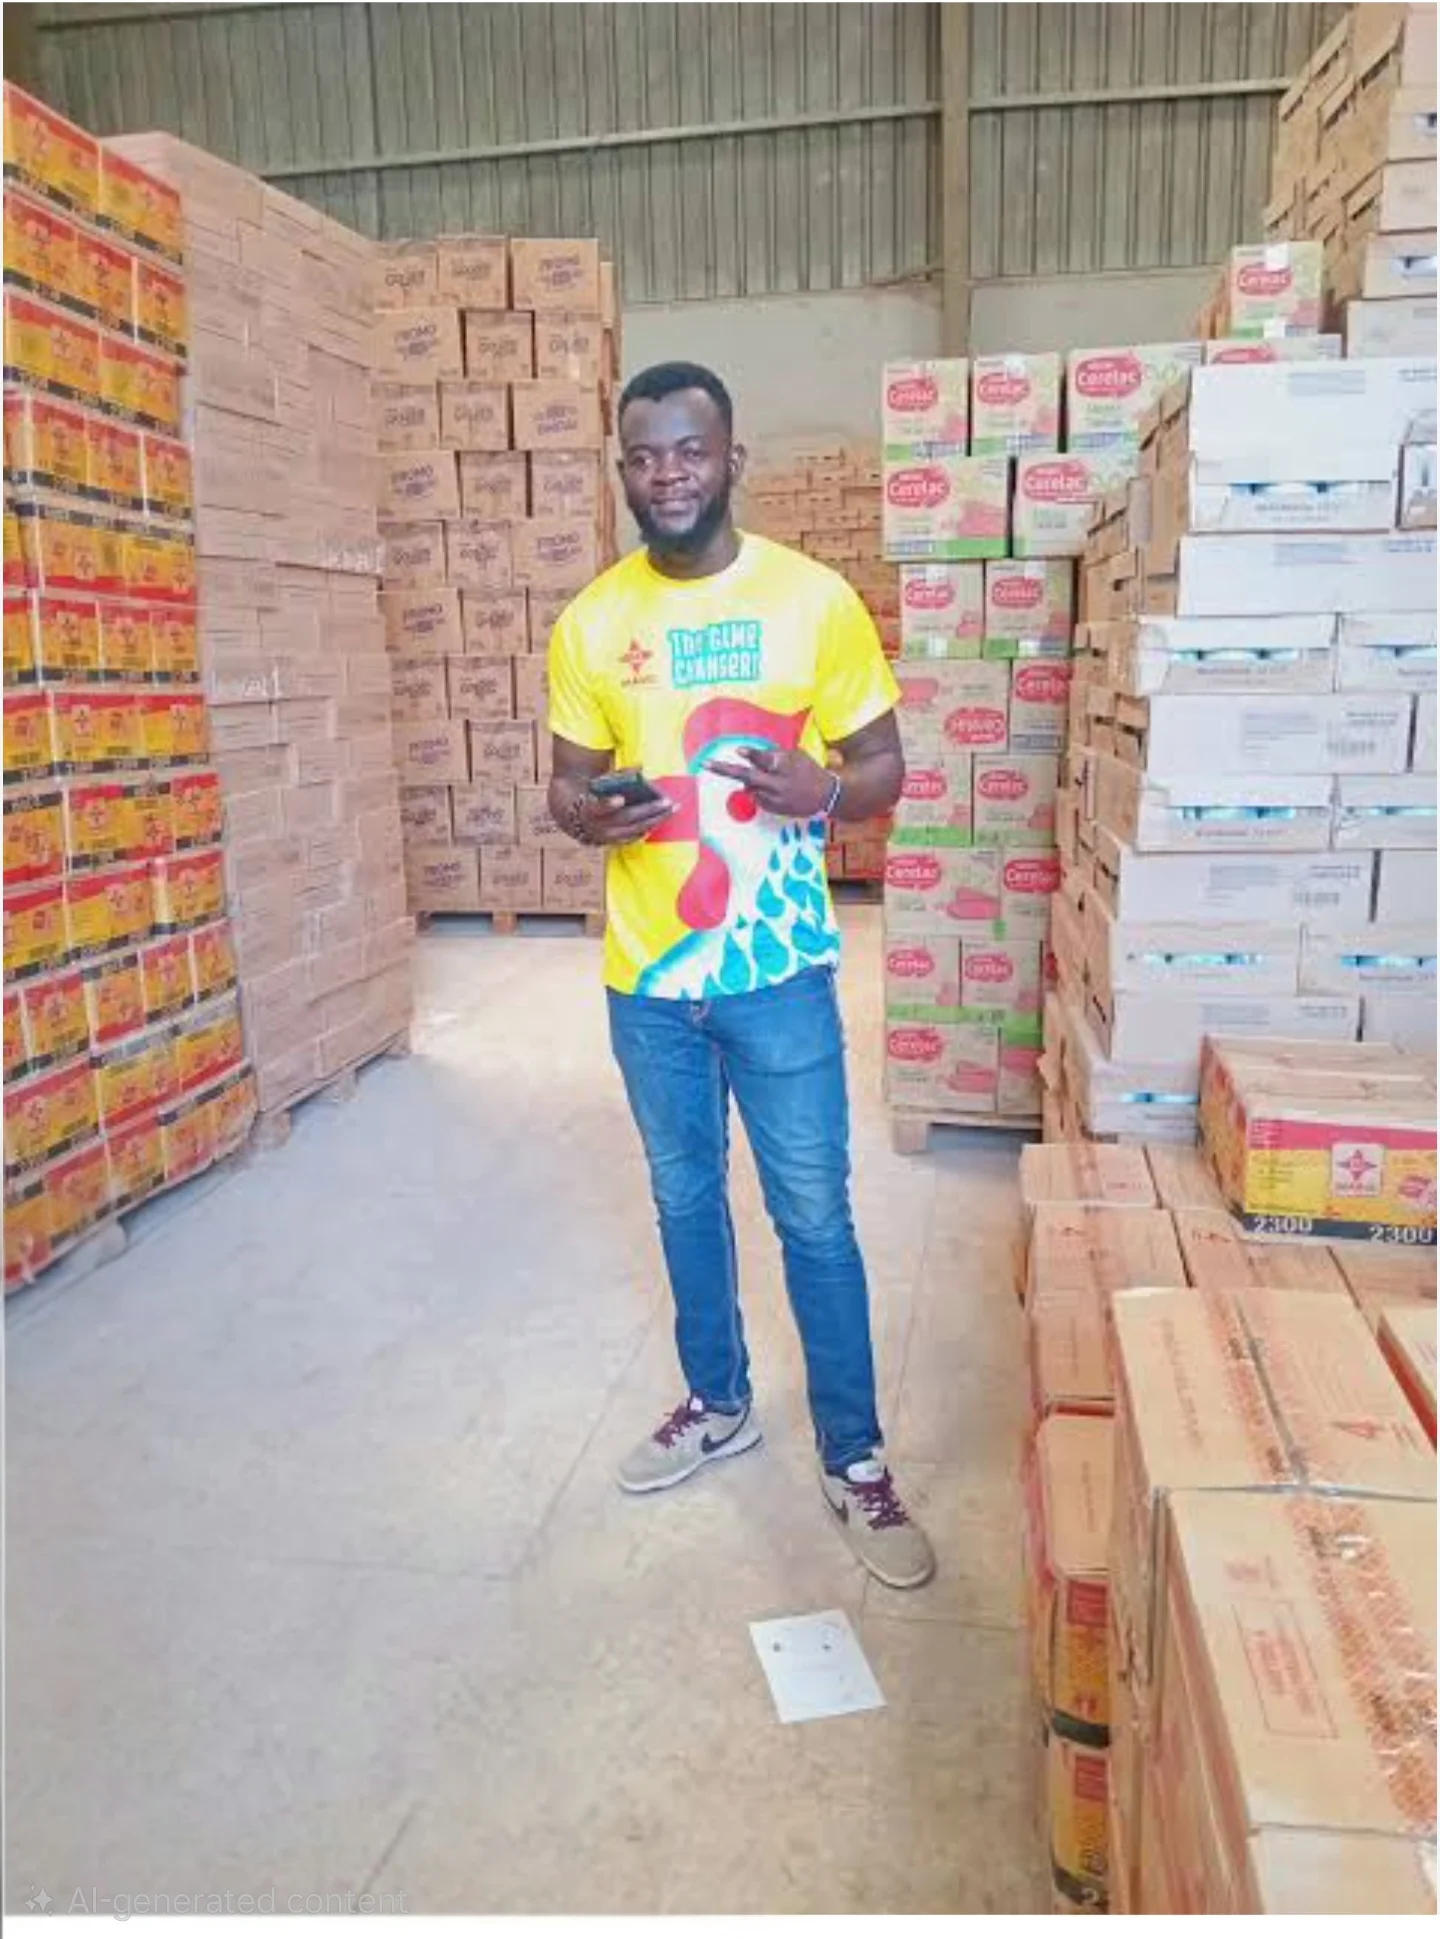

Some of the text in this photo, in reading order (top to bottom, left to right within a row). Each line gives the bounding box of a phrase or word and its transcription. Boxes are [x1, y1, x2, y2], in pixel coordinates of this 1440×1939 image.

[1077, 369, 1138, 386] Cerelac
[1254, 1214, 1313, 1234] 2300
[1368, 1224, 1434, 1243] 2300
